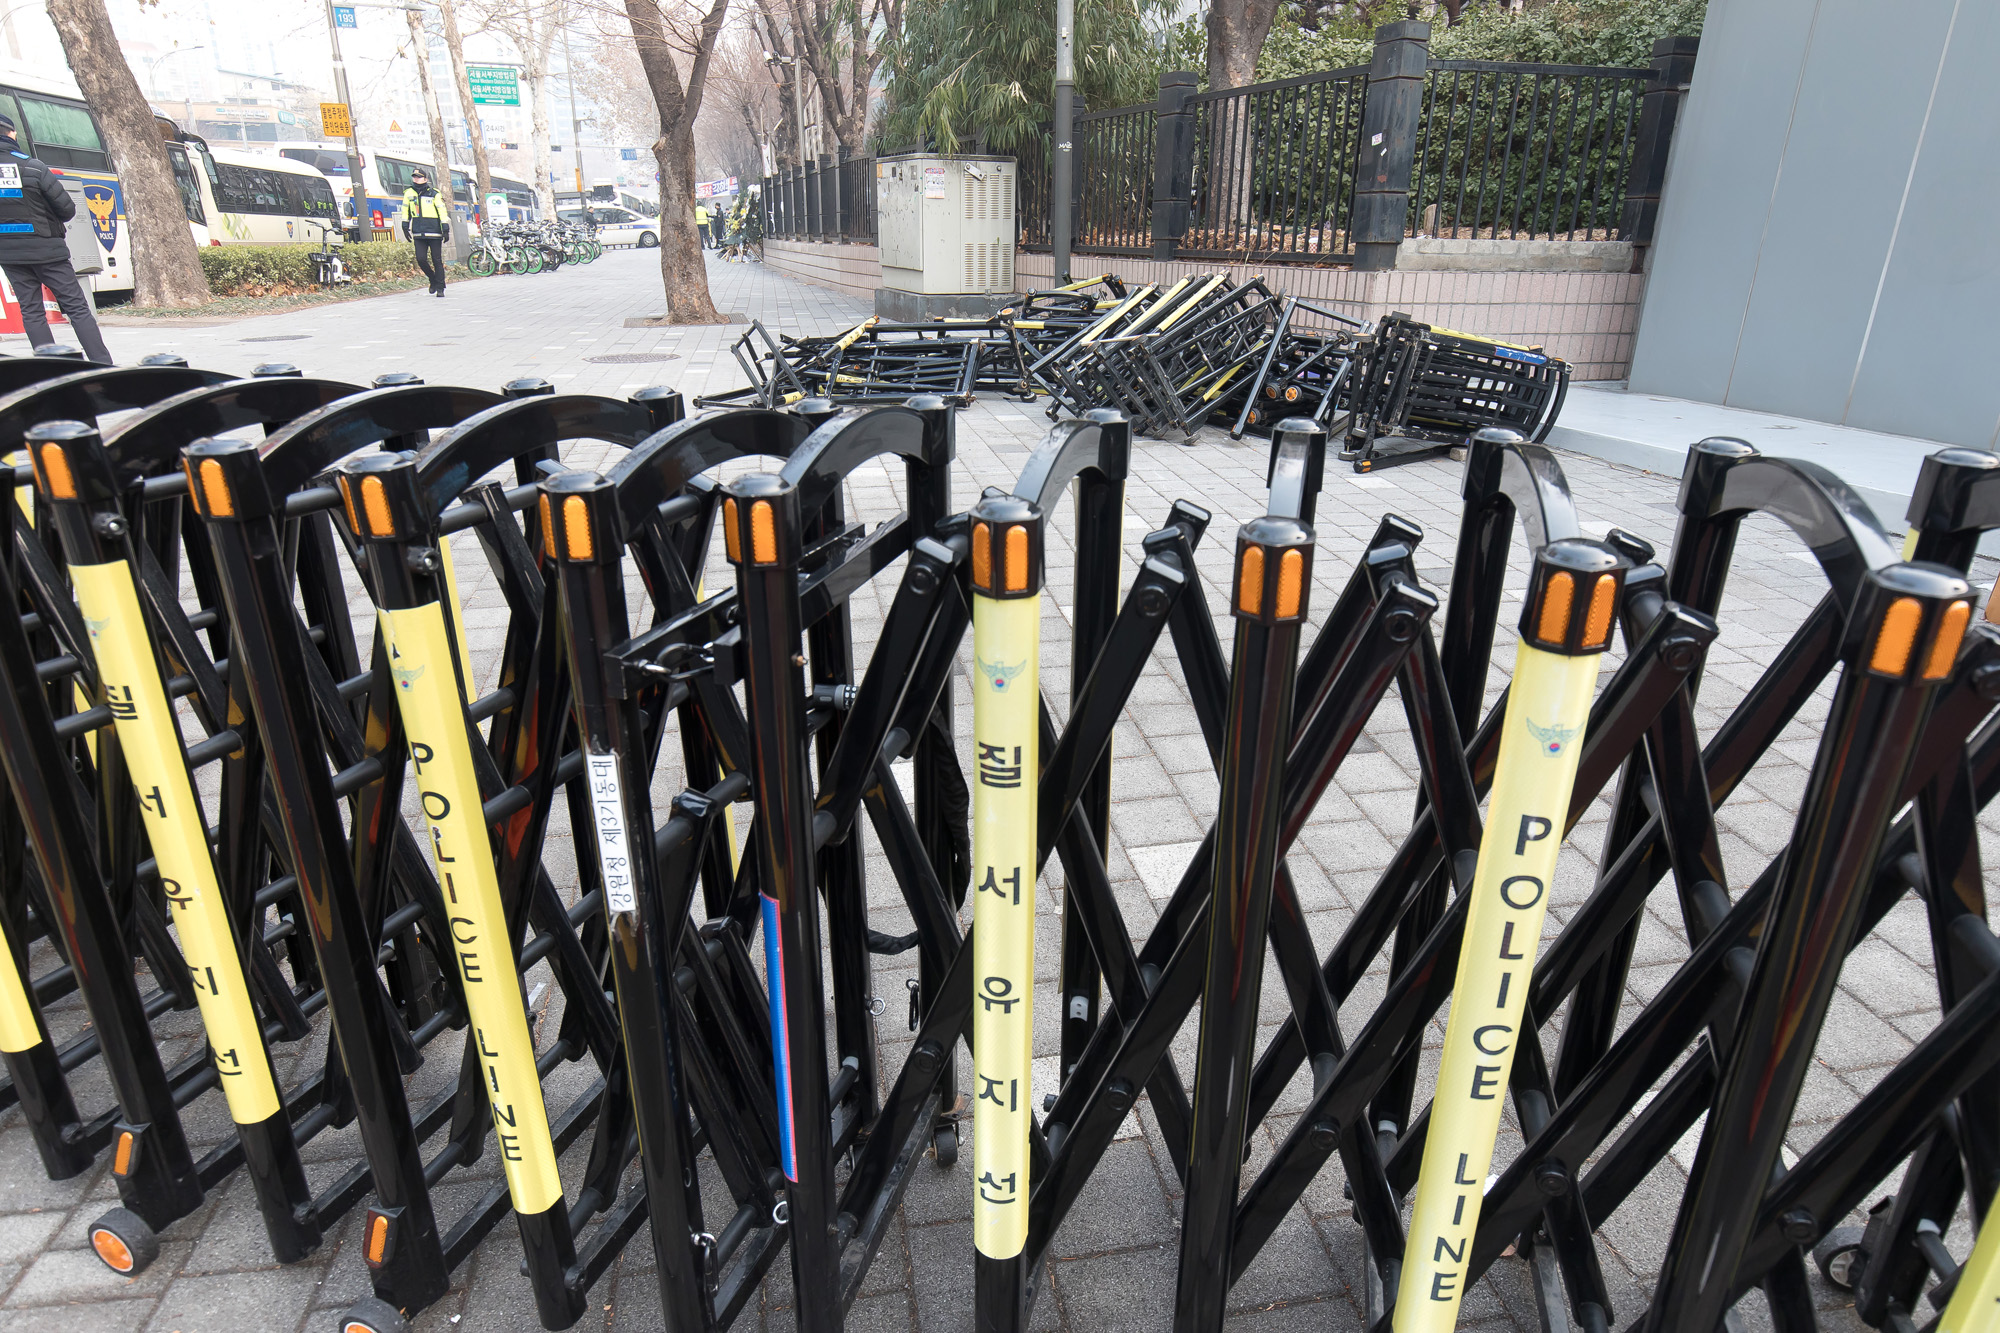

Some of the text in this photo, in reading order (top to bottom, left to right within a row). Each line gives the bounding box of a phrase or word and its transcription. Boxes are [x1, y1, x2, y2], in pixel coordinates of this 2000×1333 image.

[338, 13, 354, 23] 193
[322, 107, 348, 119] 불법주정차
[325, 121, 350, 134] 무인단속중
[485, 124, 505, 132] 24시간
[99, 232, 115, 240] POLICE
[591, 760, 633, 908] 강원청 제3기동대
[410, 740, 524, 1162] POLICE LINE
[977, 741, 1023, 1205] 질서유지선
[1429, 813, 1554, 1302] POLICE LINE
